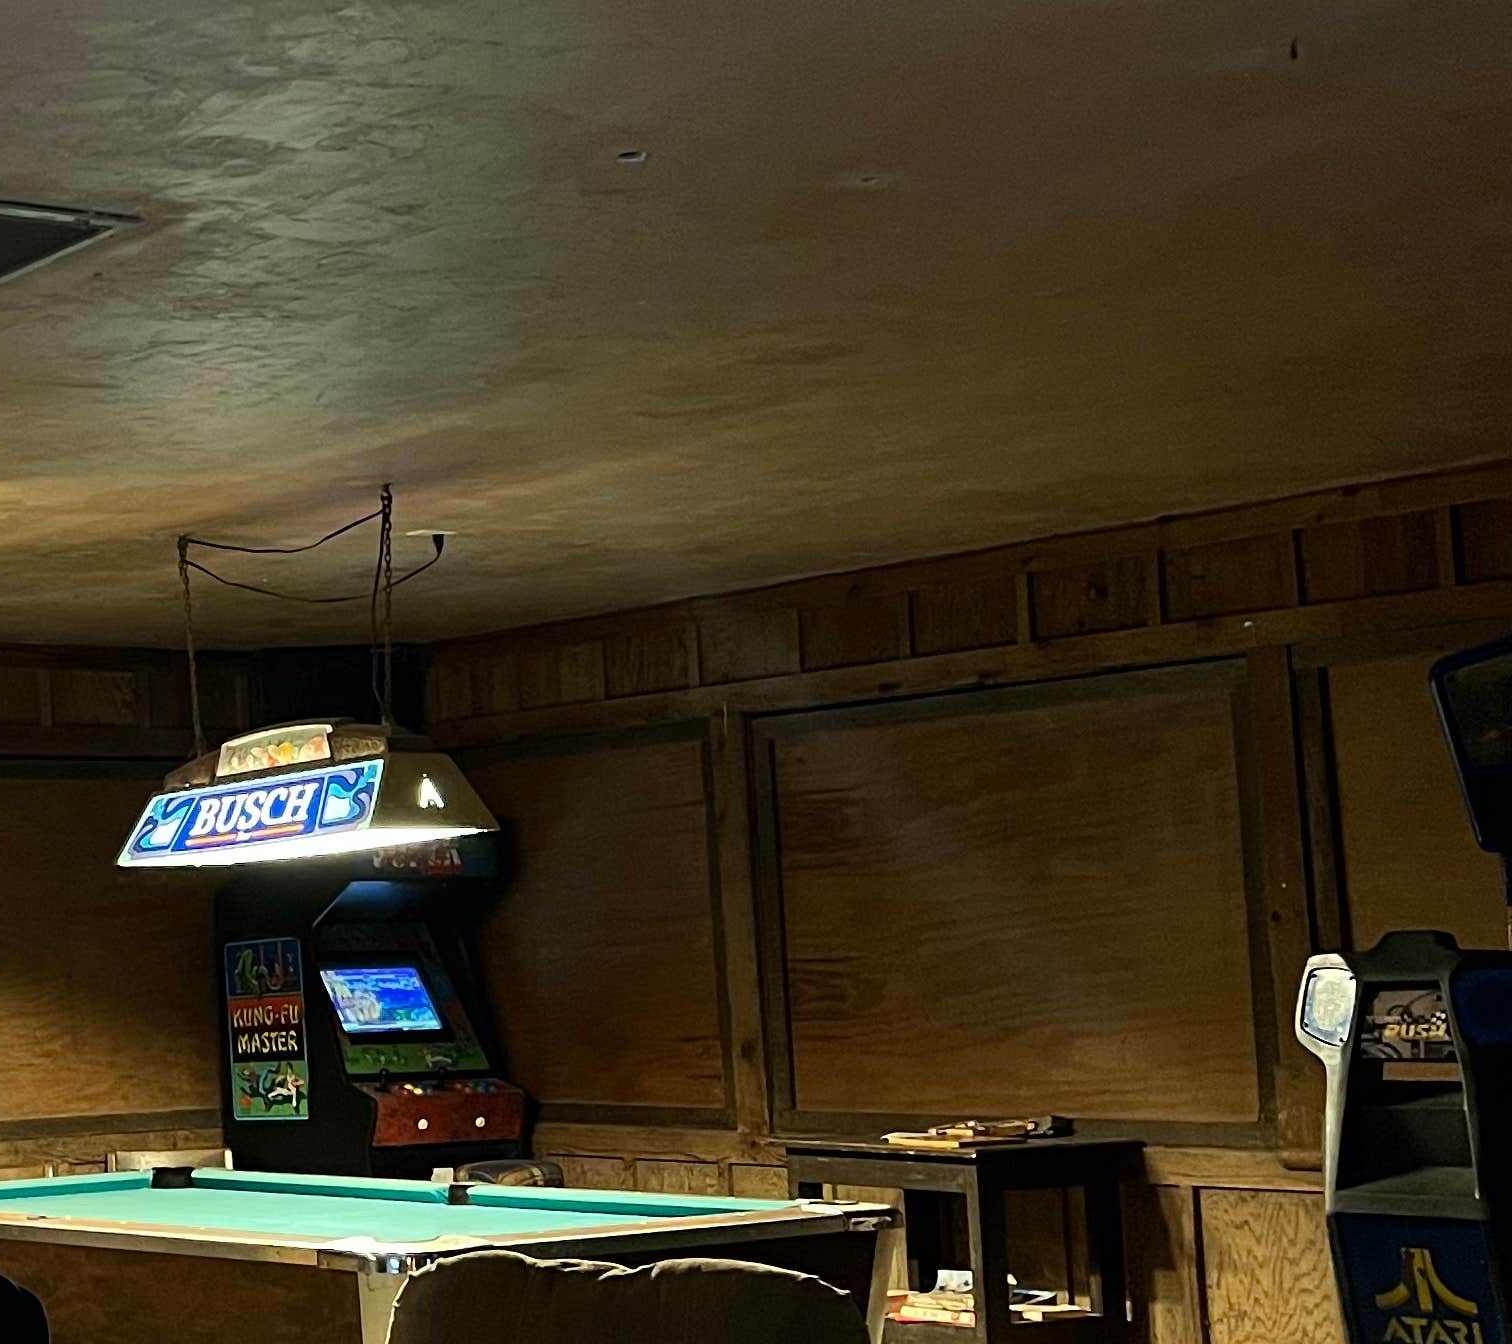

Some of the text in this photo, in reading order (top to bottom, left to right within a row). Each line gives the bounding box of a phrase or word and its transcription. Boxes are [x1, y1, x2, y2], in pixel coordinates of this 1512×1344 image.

[189, 782, 319, 837] BUSCH
[233, 1003, 299, 1028] KUNG-FU
[237, 1030, 298, 1054] MASTER
